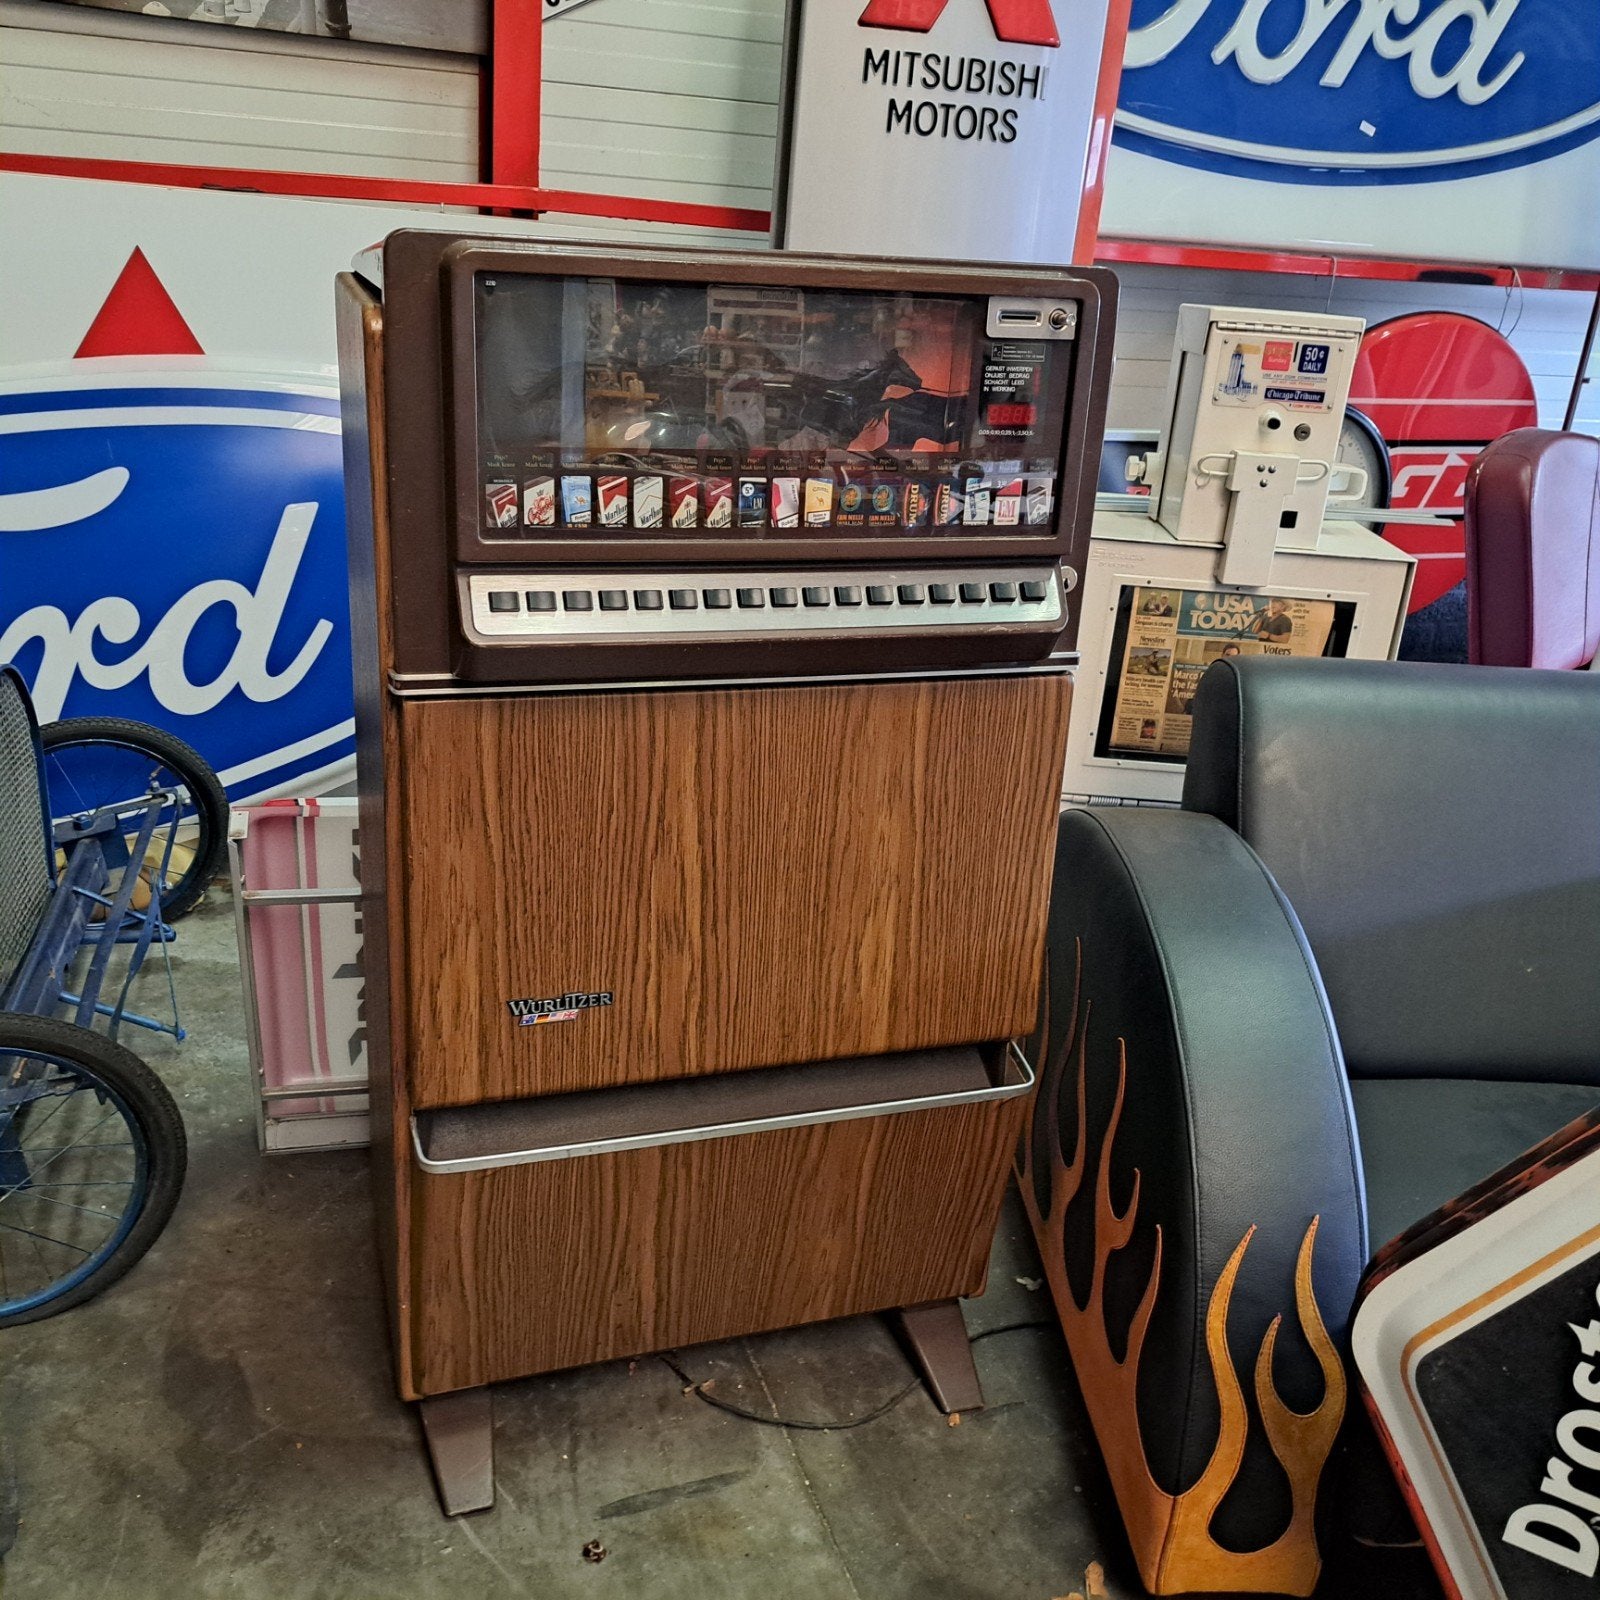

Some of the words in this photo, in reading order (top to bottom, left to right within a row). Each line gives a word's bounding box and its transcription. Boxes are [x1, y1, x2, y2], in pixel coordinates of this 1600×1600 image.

[1121, 0, 1526, 106] ord
[886, 98, 1018, 143] MOTORS
[1302, 362, 1322, 372] DAILY
[1266, 389, 1294, 401] Chicago
[1294, 390, 1321, 402] Tribune
[909, 484, 920, 524] DRUM
[940, 484, 951, 524] DRUM
[1213, 594, 1255, 613] USA
[1190, 610, 1257, 631] TODAY
[1263, 645, 1292, 656] Voters
[1173, 670, 1199, 680] Marco
[1173, 680, 1186, 689] the
